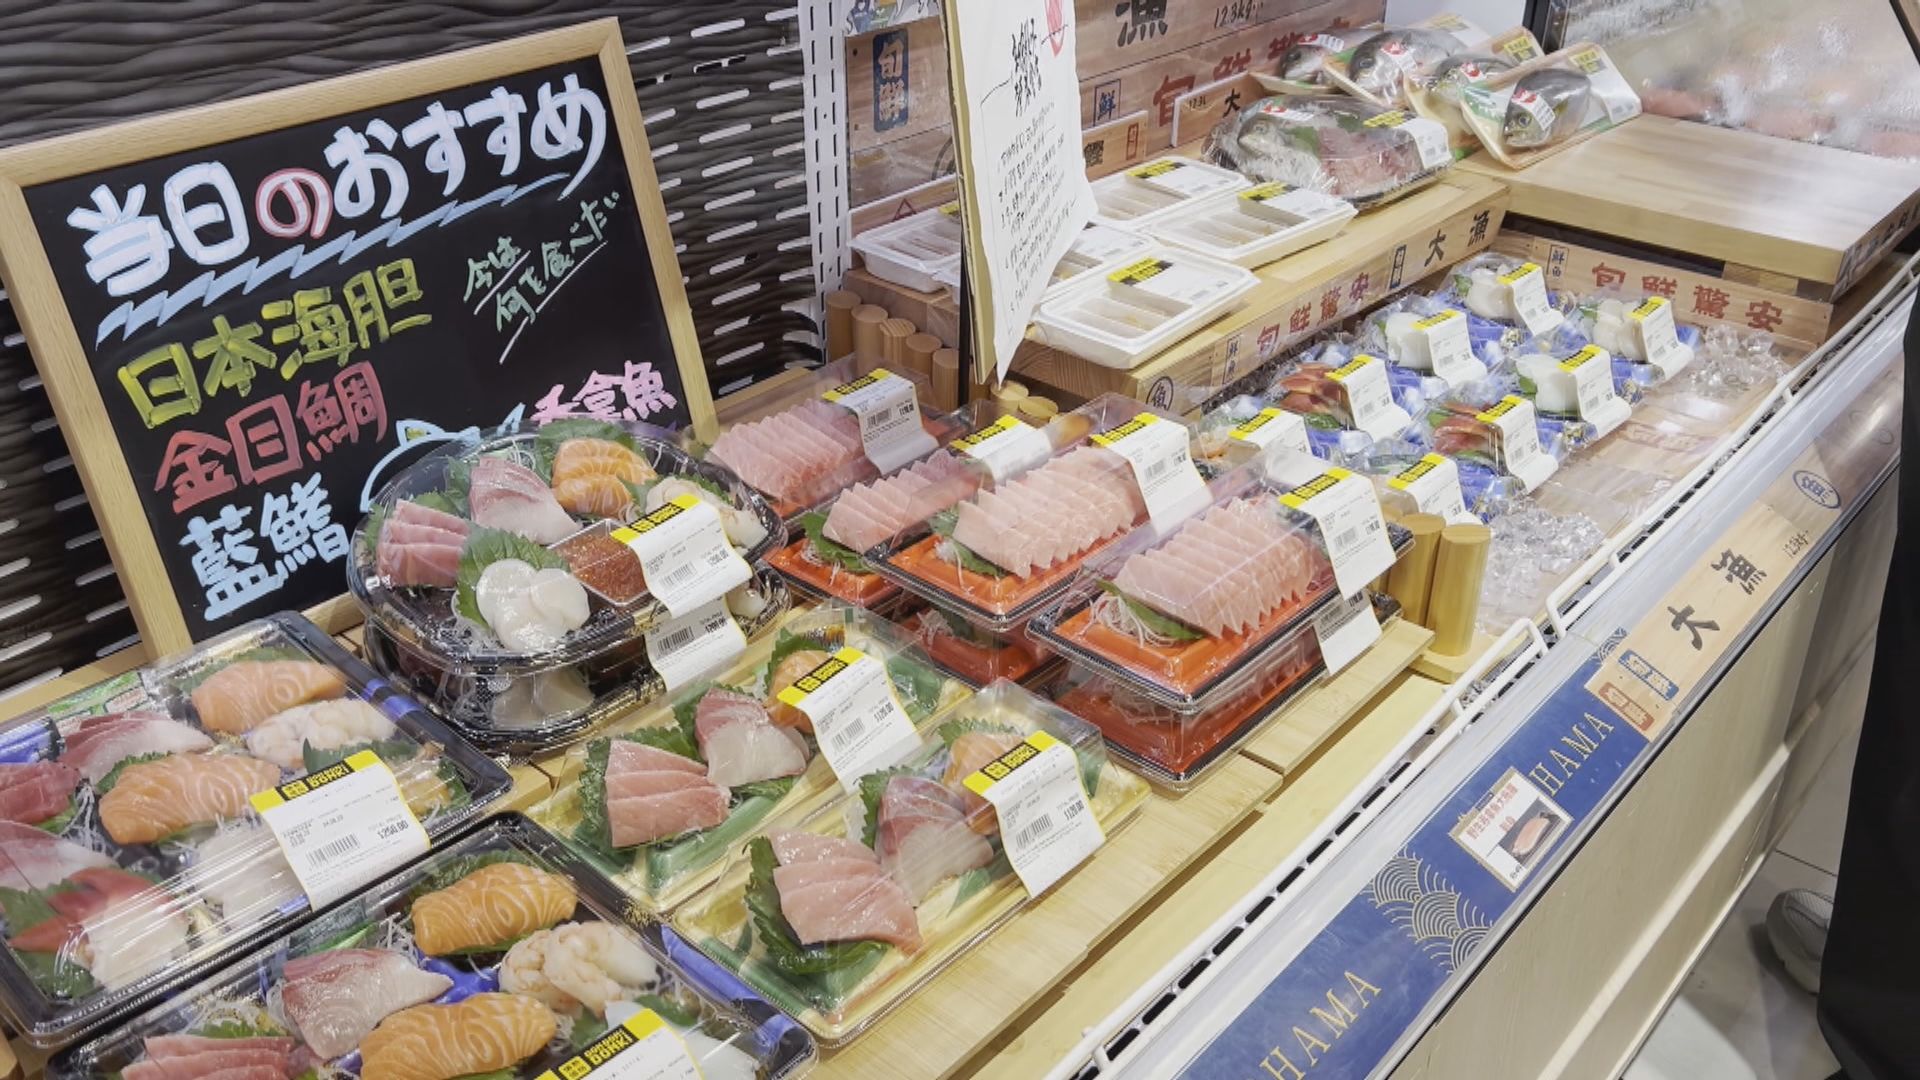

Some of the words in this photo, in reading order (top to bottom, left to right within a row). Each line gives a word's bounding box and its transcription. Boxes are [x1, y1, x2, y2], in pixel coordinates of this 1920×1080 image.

[1222, 88, 1241, 118] 大
[67, 73, 608, 298] 当日のおすすめ
[1424, 210, 1490, 267] 大漁
[117, 257, 432, 429] 日本海胆
[154, 360, 389, 513] 金目鯛
[1667, 549, 1767, 650] 大漁
[1529, 710, 1614, 796] HAMA
[588, 1033, 634, 1066] DONKI
[1259, 970, 1381, 1080] HAMA
